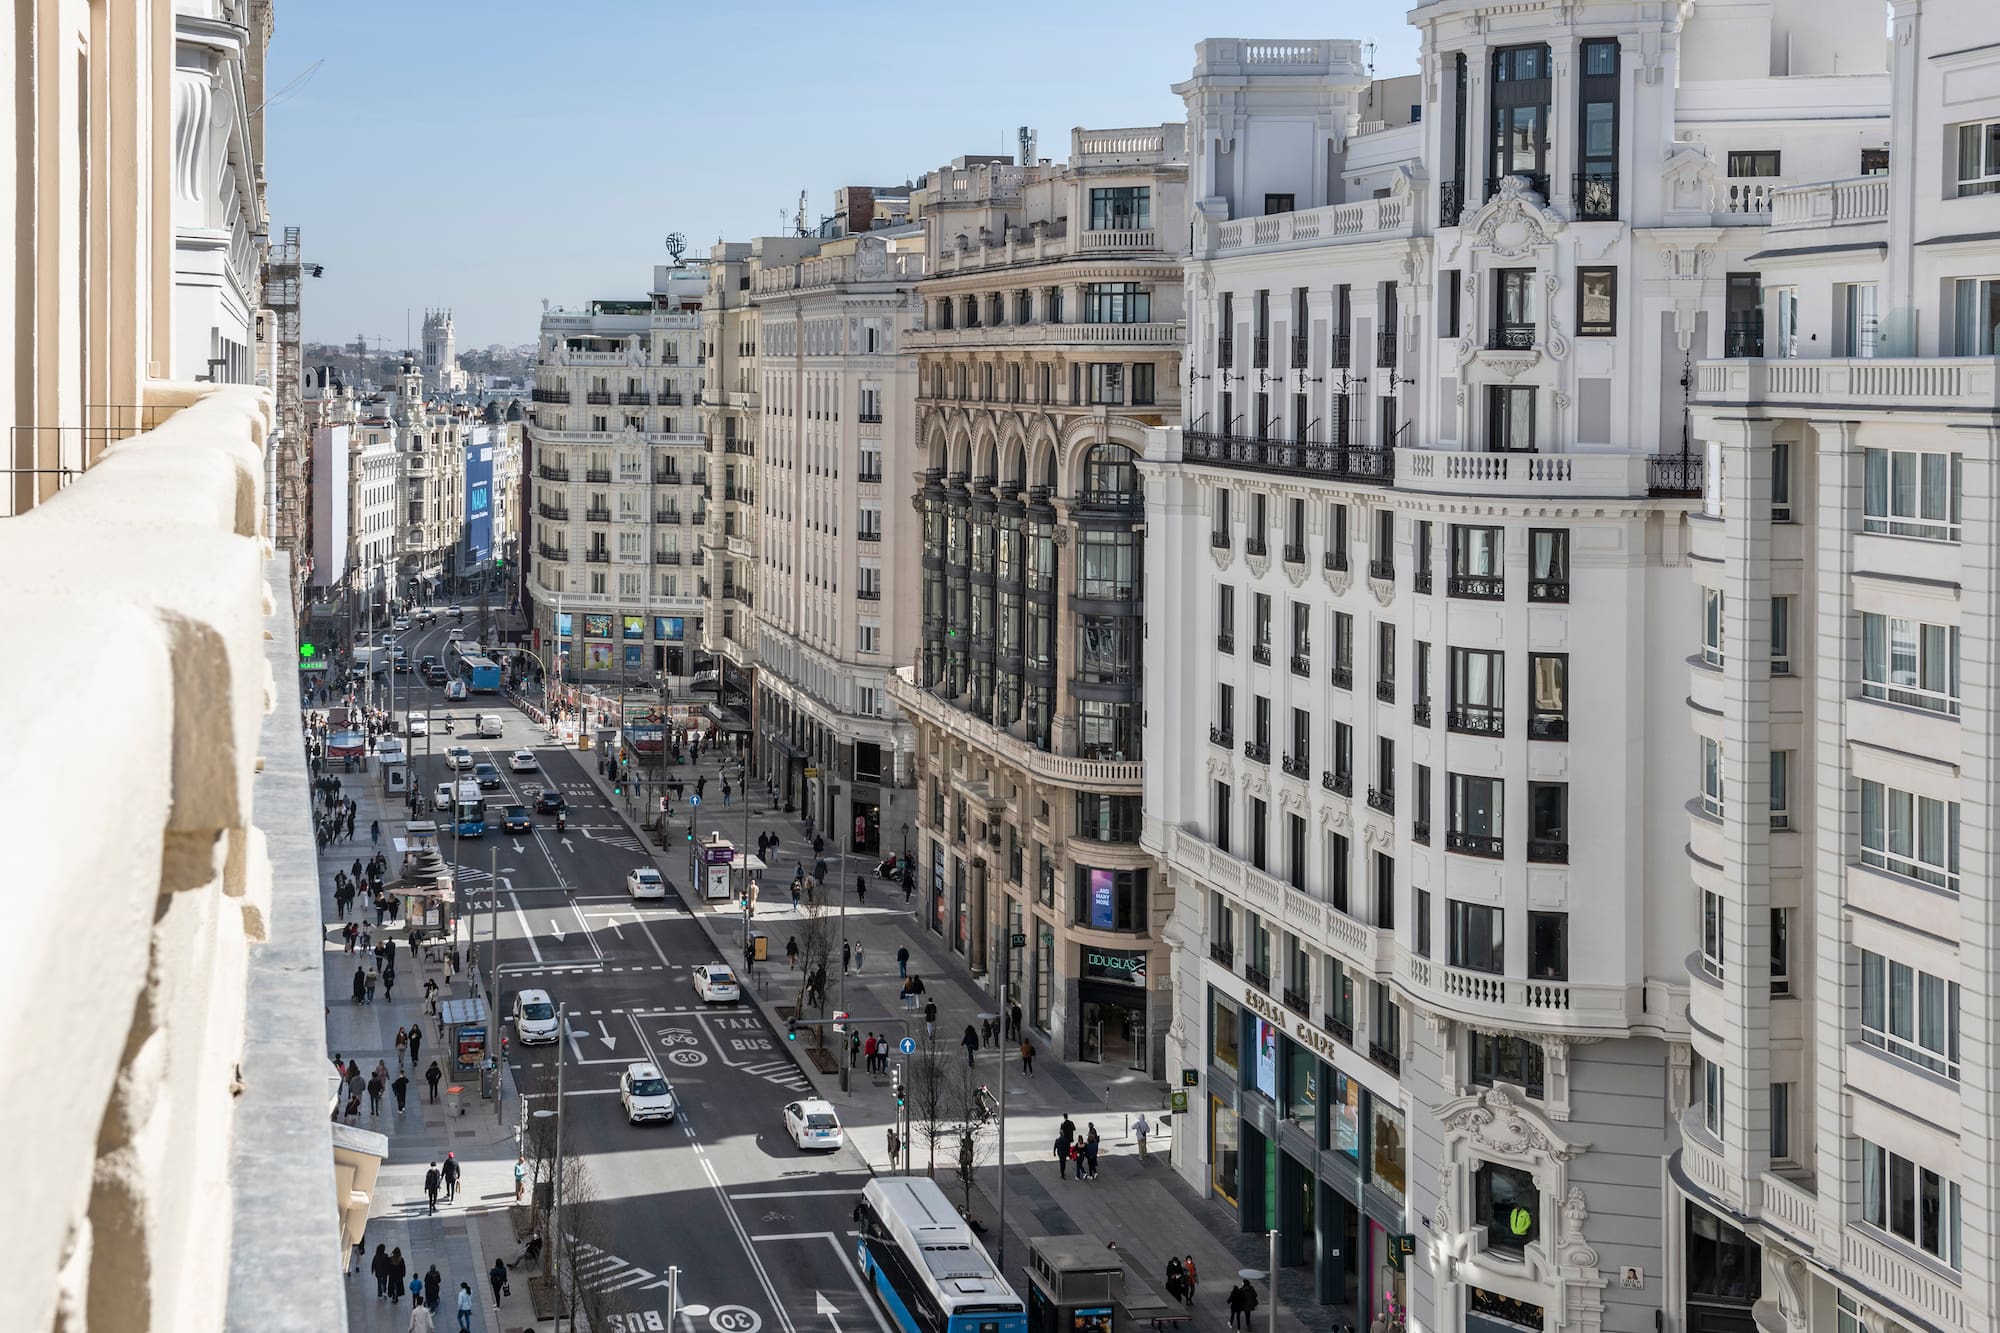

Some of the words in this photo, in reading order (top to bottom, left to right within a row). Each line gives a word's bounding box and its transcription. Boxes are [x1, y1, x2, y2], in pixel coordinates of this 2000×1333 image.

[466, 900, 505, 910] TAXI
[1088, 953, 1137, 971] DOUGLAS
[714, 1018, 762, 1029] TAXI
[1245, 988, 1286, 1028] ESPASA
[1296, 1022, 1335, 1060] CALPE
[730, 1039, 773, 1051] BUS
[678, 1053, 699, 1063] 30
[607, 1310, 664, 1333] BUS
[721, 1312, 752, 1329] 30
